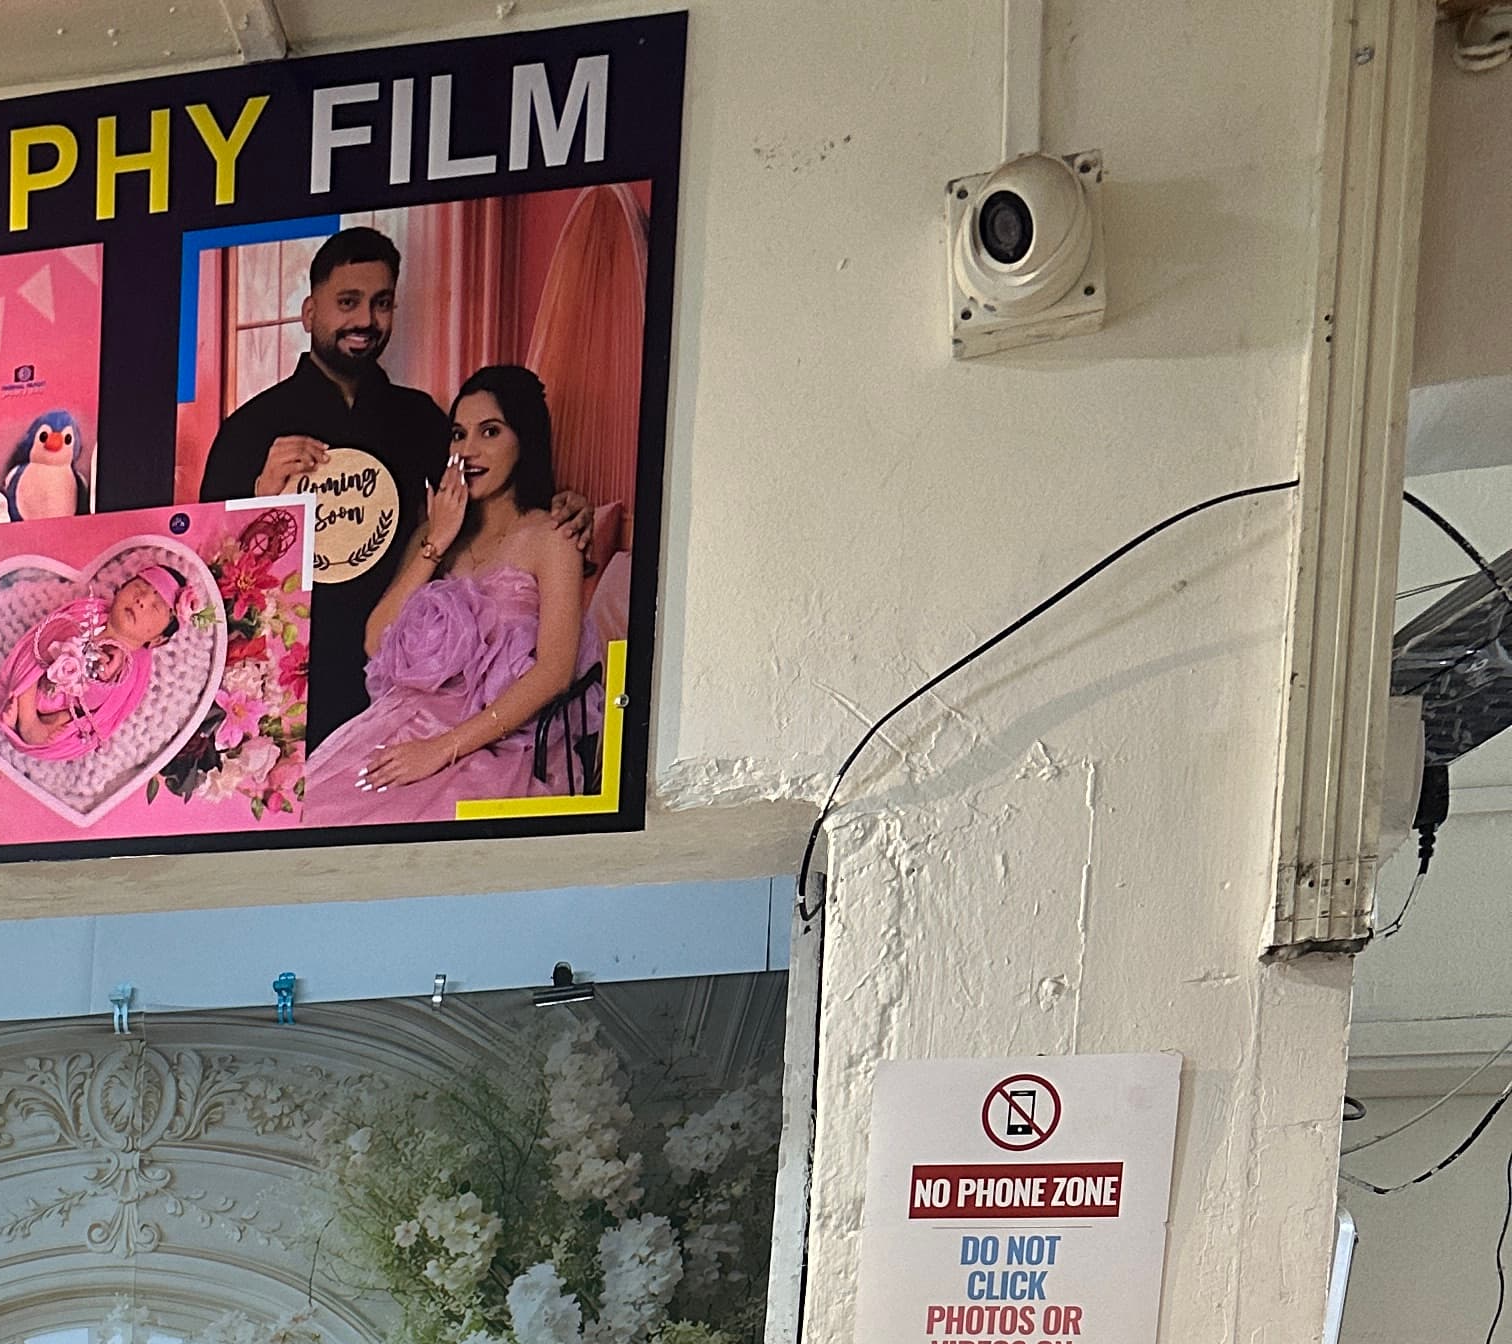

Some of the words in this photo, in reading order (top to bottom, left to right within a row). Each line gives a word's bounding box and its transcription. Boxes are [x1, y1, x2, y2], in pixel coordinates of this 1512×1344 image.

[309, 53, 610, 195] FILM
[314, 503, 365, 532] Soon
[914, 1178, 951, 1208] NO
[956, 1177, 1047, 1208] PHONE
[1050, 1176, 1119, 1207] ZONE
[960, 1236, 1000, 1265] DO
[1006, 1235, 1061, 1265] NOT
[967, 1270, 1048, 1300] CLICK
[926, 1305, 1036, 1336] PHOTOS
[1042, 1305, 1082, 1336] OR
